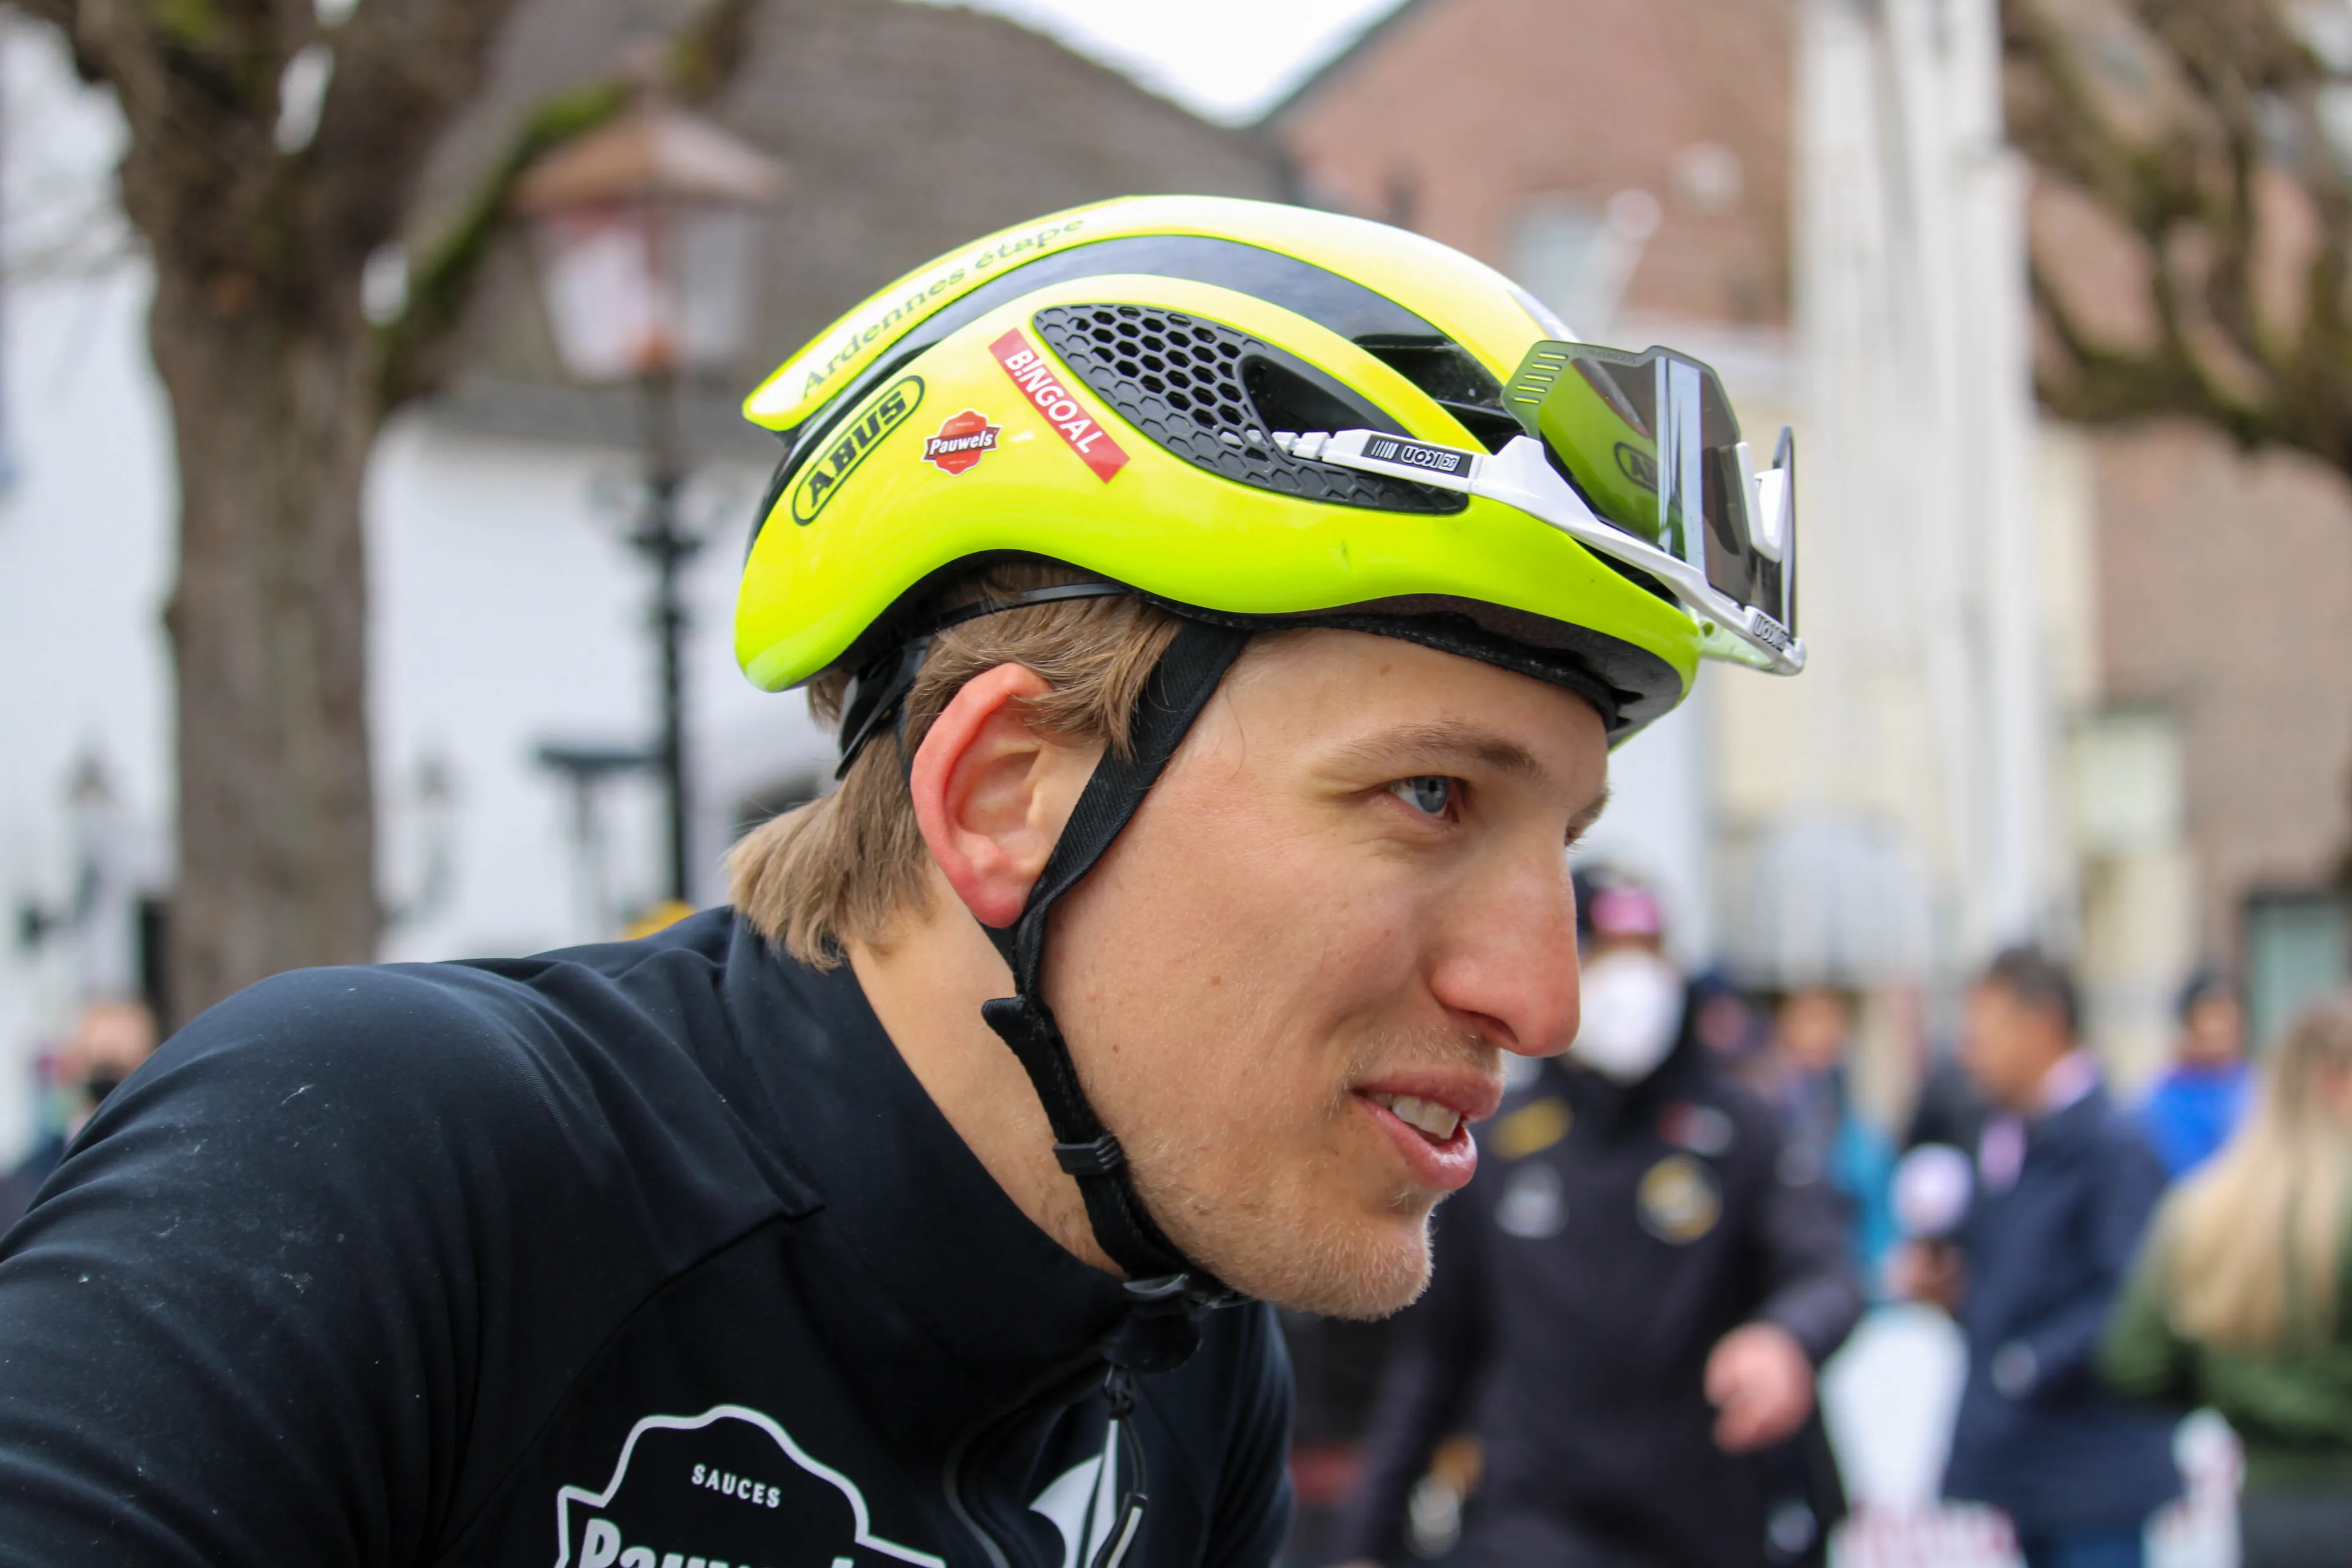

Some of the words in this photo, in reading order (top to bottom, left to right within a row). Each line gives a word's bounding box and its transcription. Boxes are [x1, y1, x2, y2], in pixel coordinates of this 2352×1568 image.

[802, 268, 966, 400] Ardennes
[975, 218, 1084, 269] étape
[809, 390, 907, 508] ABUS
[929, 430, 993, 455] Pauwels
[691, 1463, 781, 1508] SAUCES
